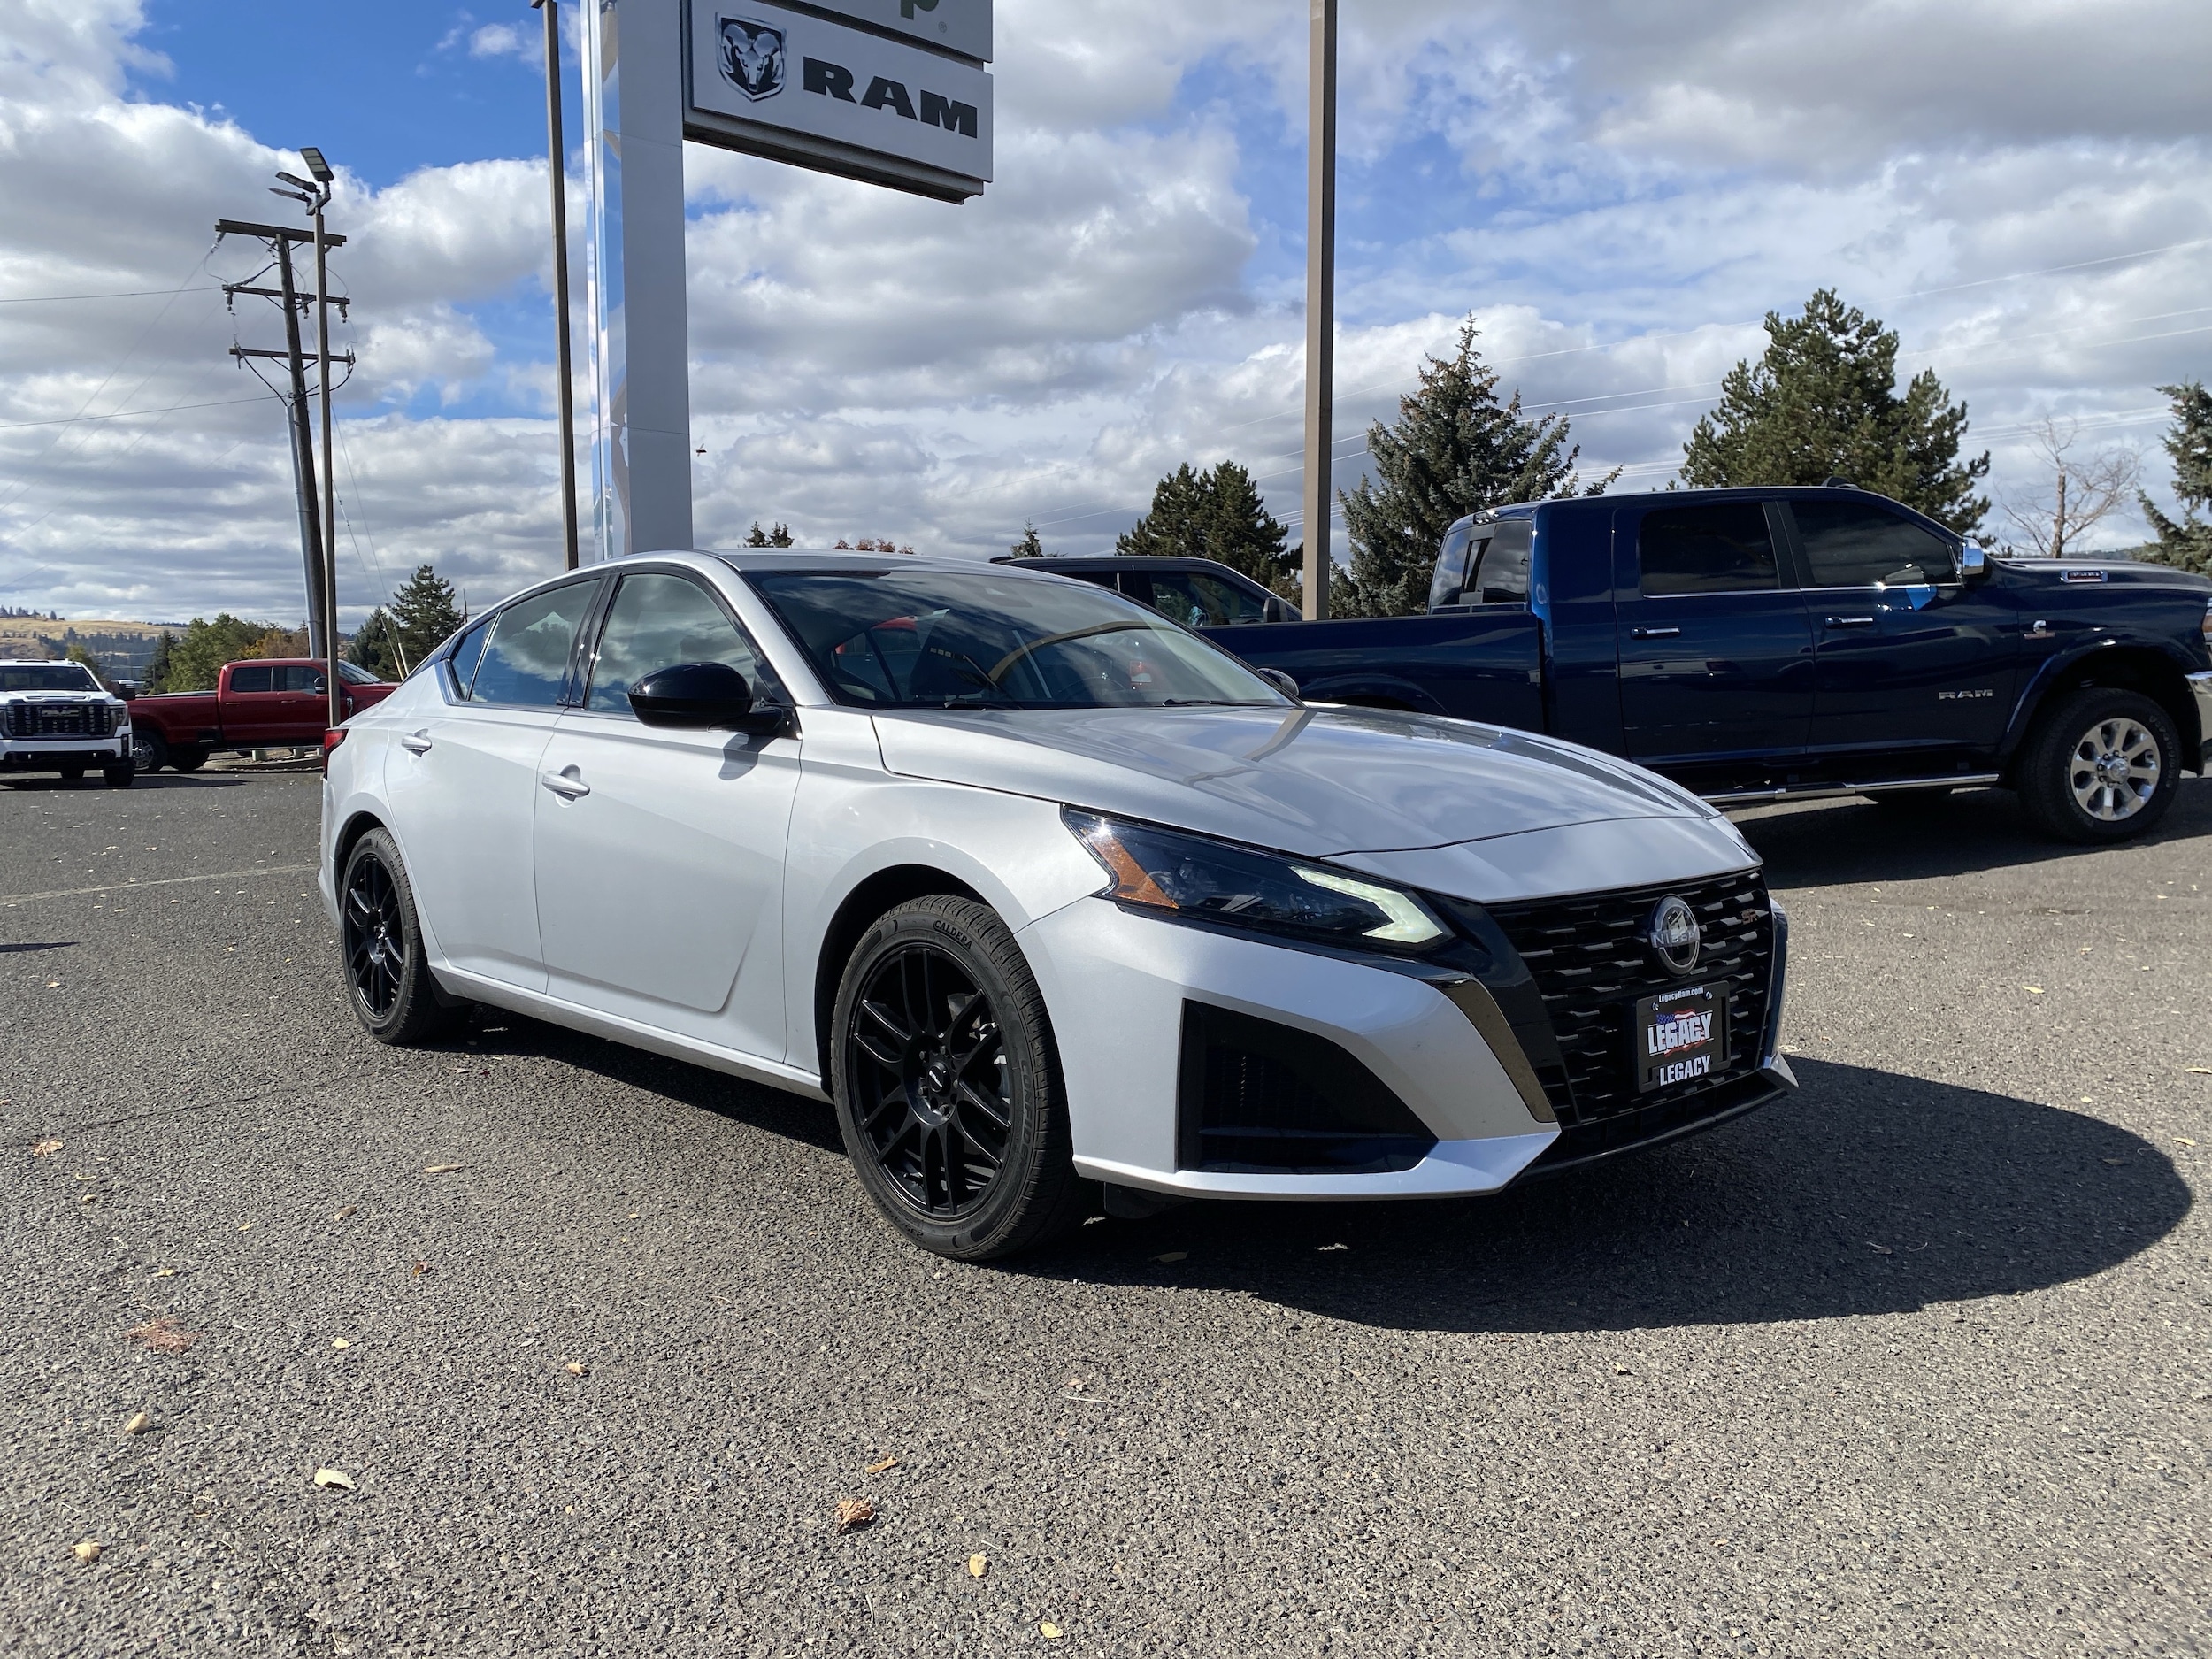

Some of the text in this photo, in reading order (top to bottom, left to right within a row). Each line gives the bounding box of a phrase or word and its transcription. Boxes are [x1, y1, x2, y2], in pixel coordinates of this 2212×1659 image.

[803, 56, 978, 139] RAM
[1939, 689, 1993, 700] RAM
[1741, 909, 1757, 925] SR
[933, 920, 973, 949] CALDERA
[1647, 1012, 1713, 1054] LEGACY
[1660, 1055, 1711, 1087] LEGACY
